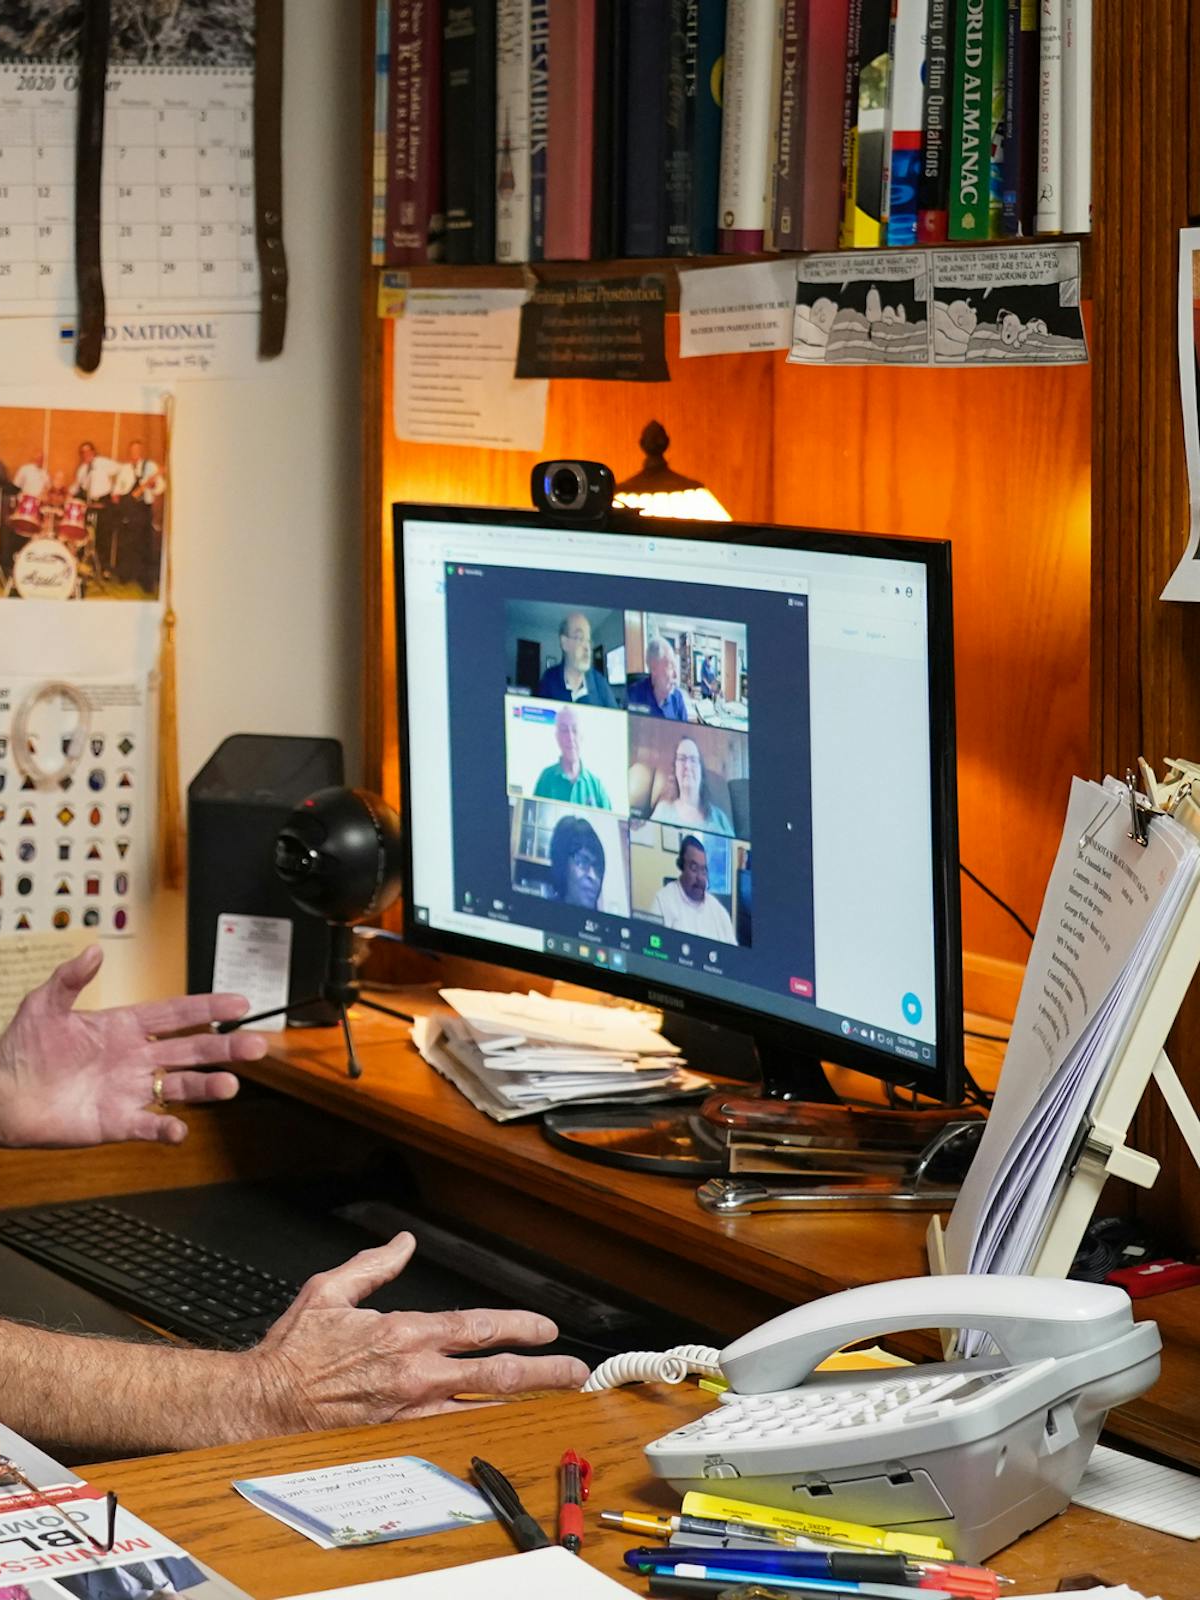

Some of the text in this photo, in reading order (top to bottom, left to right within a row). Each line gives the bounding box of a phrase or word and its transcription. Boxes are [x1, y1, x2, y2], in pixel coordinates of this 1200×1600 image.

[16, 75, 57, 91] 2020
[394, 43, 411, 180] REFERENCE
[404, 2, 421, 181] New York Public Library
[526, 0, 552, 154] THESAURUS
[779, 46, 797, 180] Dictionary
[924, 35, 946, 178] of Film Quotations
[959, 0, 983, 205] ORLD ALMANAC
[842, 99, 851, 167] SENIORS
[1039, 71, 1050, 173] PAUL DICKSON
[960, 273, 975, 281] THAT
[977, 273, 993, 281] NEED
[995, 271, 1027, 280] WORKING
[1016, 260, 1033, 269] STILL
[1043, 259, 1060, 269] FEW
[1020, 251, 1037, 260] THAT
[122, 323, 217, 341] NATIONAL
[647, 991, 685, 1009] SAMSUNG
